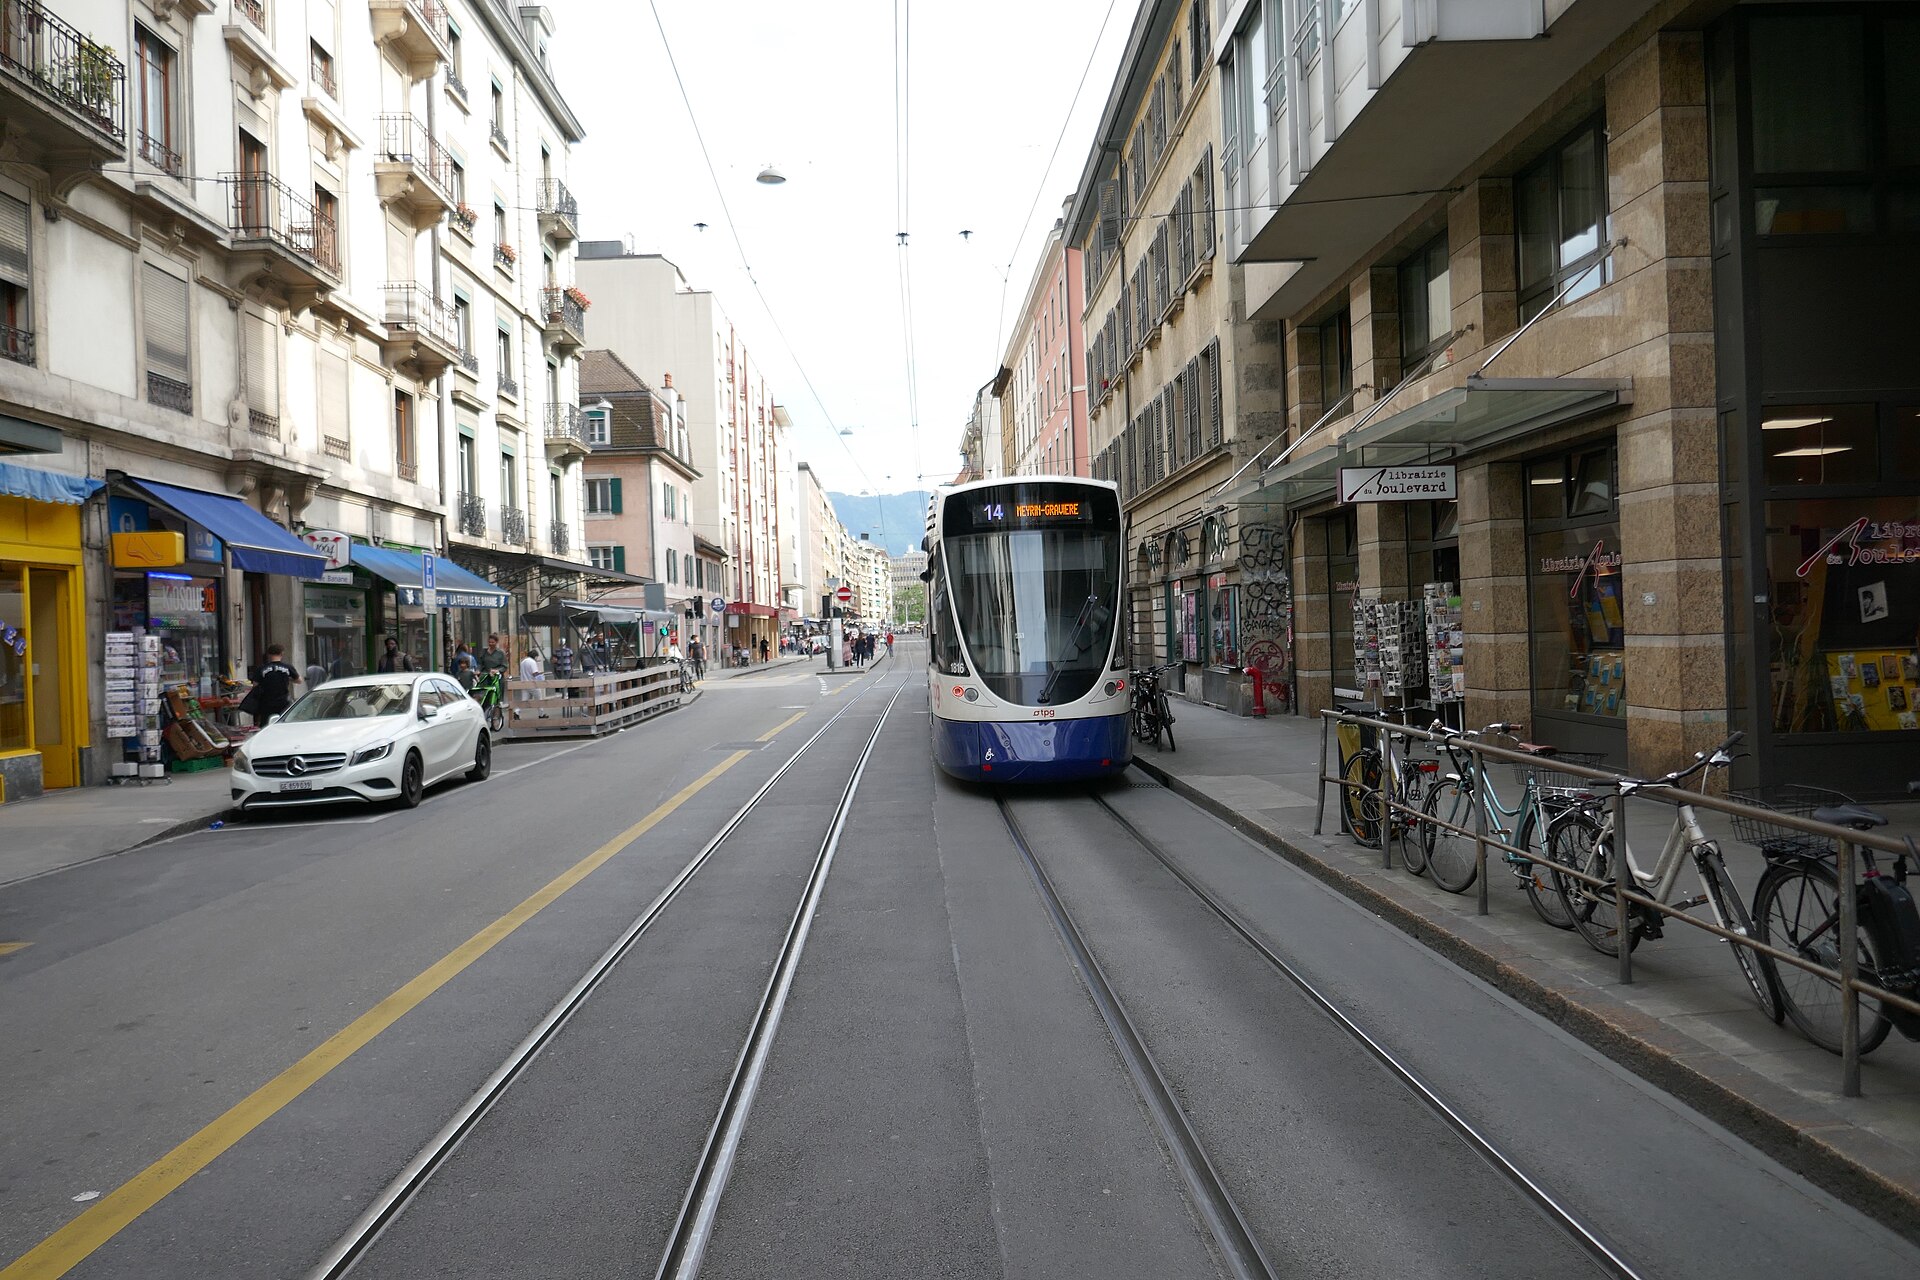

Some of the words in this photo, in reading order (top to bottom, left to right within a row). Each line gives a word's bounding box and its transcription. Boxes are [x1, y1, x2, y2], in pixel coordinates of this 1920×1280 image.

[1389, 470, 1446, 480] librairie
[984, 504, 1004, 521] 14
[426, 557, 432, 572] P
[950, 662, 965, 674] 1816
[1040, 709, 1055, 718] tpg
